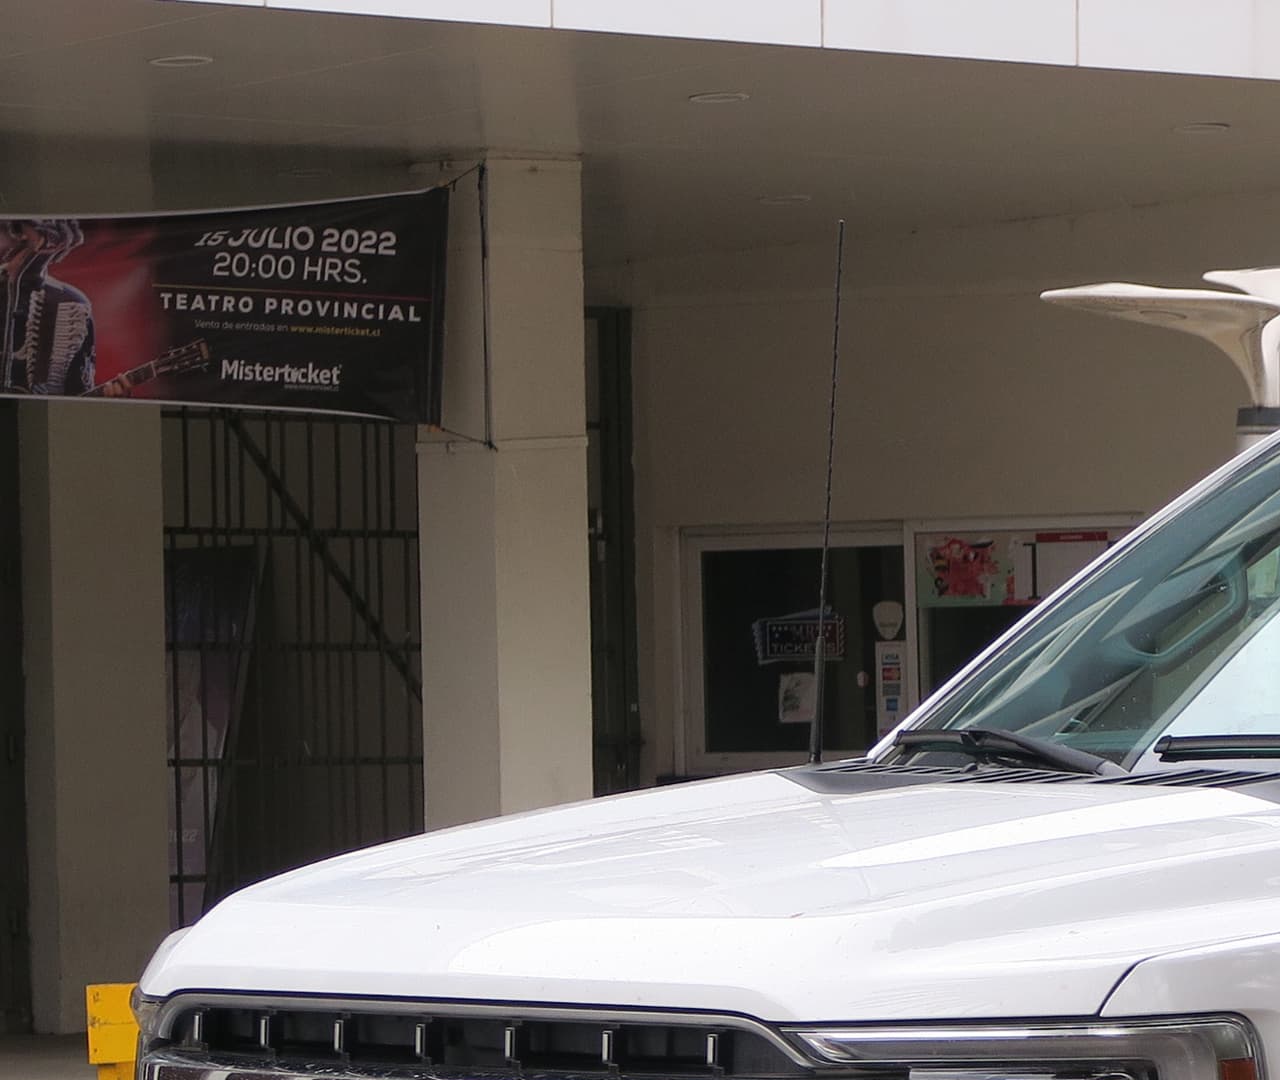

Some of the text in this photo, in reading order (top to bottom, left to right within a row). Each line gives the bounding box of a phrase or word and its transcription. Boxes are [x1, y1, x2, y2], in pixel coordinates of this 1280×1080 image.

[227, 225, 315, 251] JULIO
[322, 229, 397, 256] 2022
[212, 252, 368, 285] 20:00 HRS.
[160, 292, 422, 323] TEATRO PROVINCIAL
[771, 642, 837, 655] TICKES
